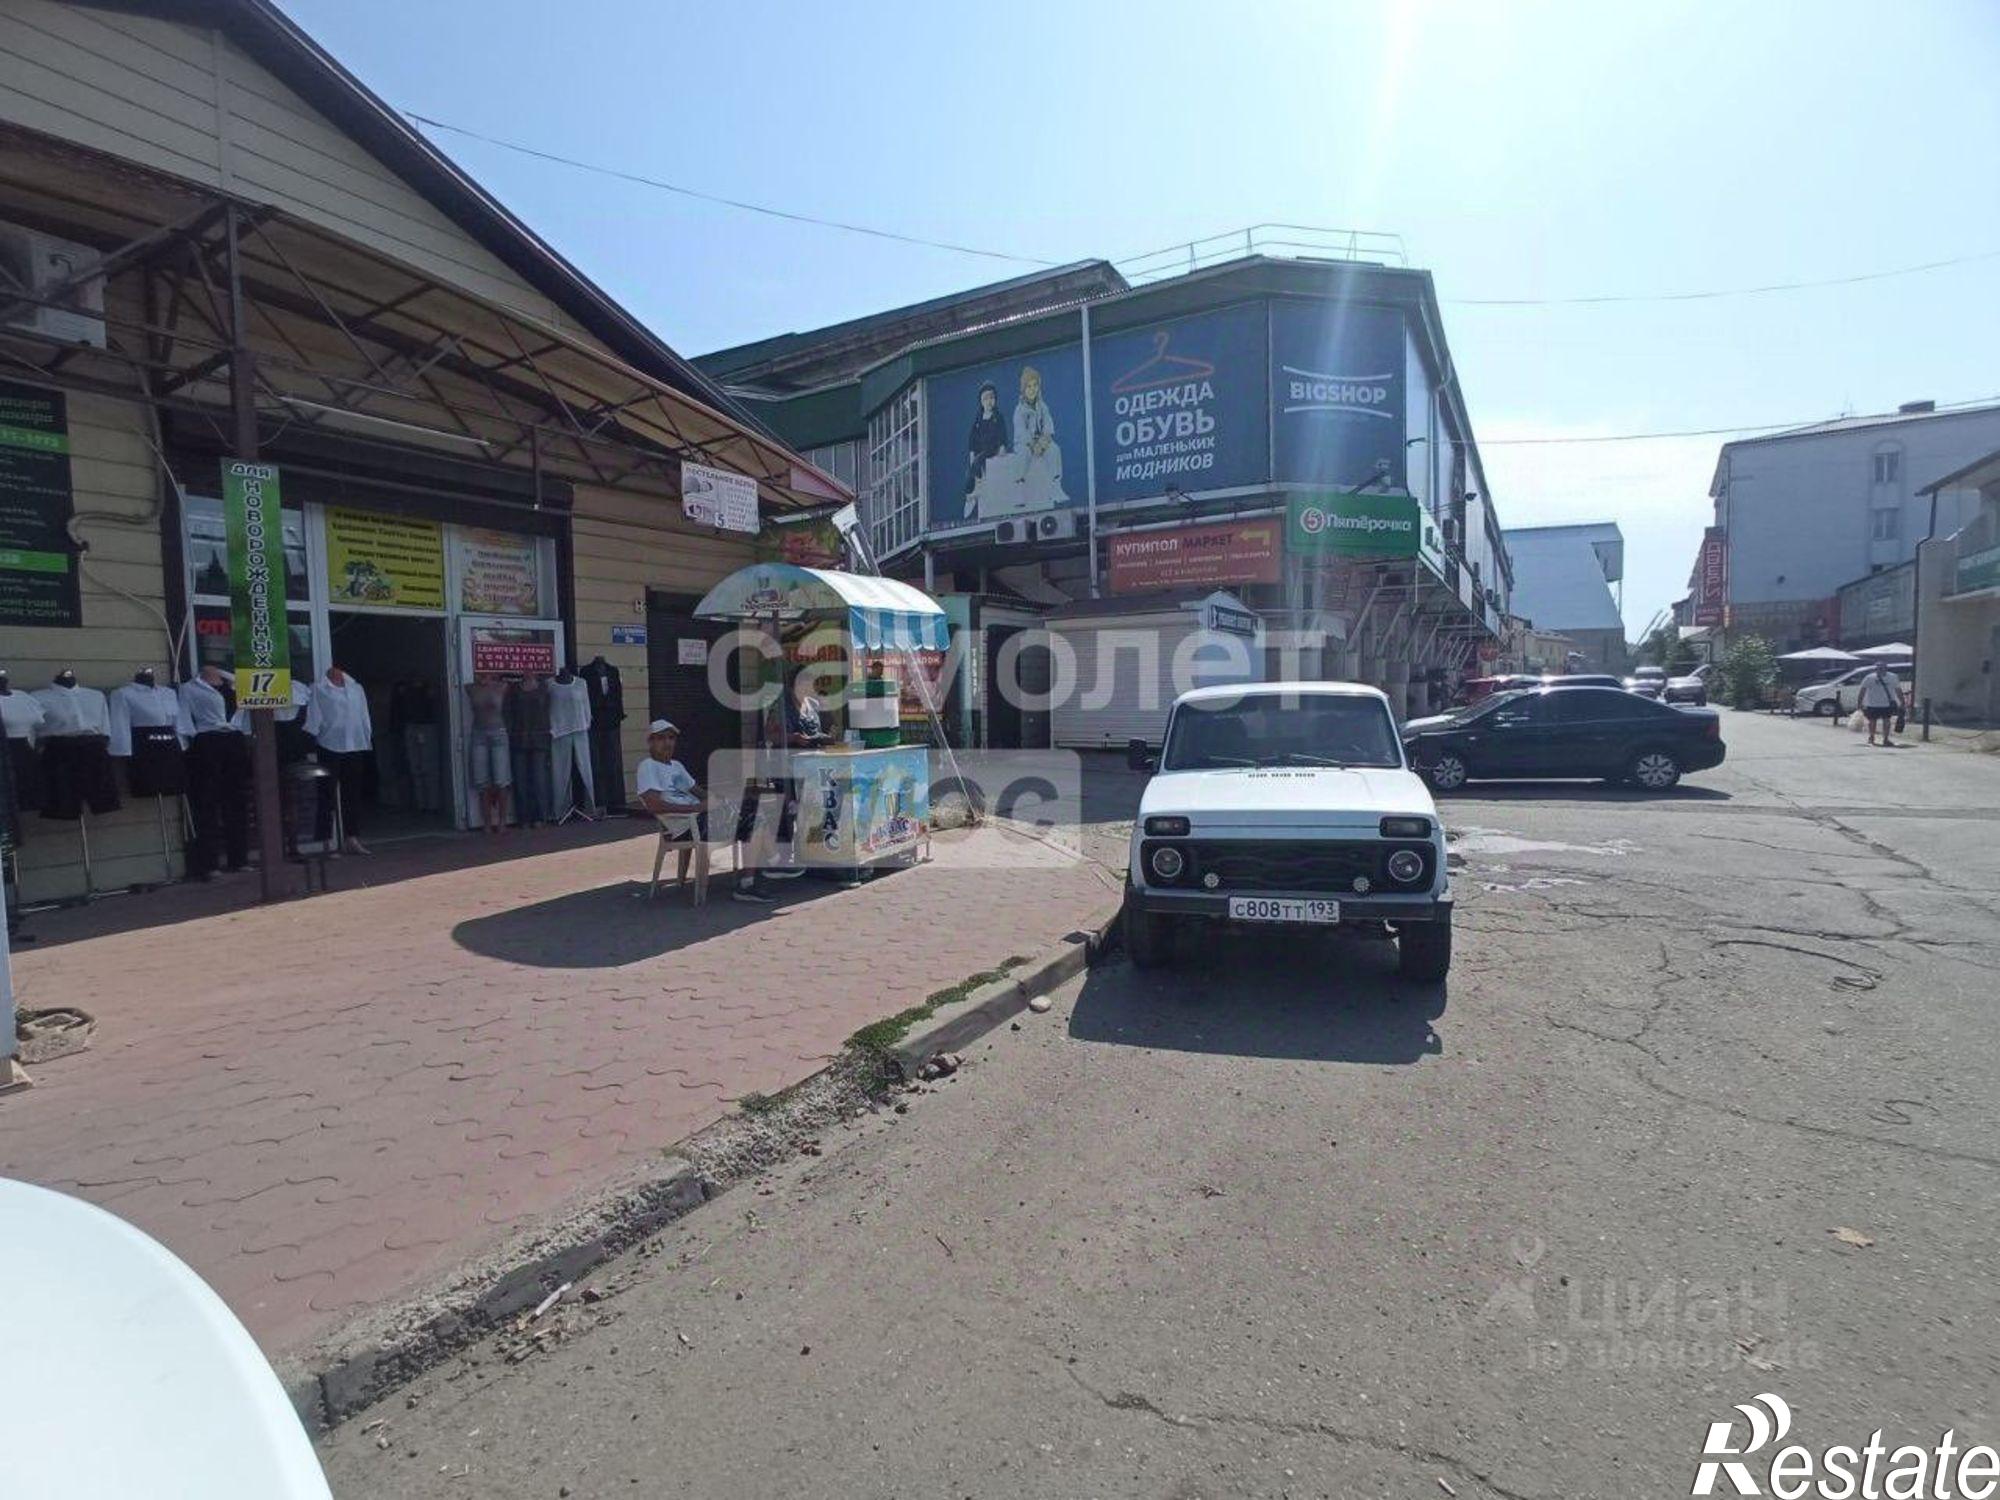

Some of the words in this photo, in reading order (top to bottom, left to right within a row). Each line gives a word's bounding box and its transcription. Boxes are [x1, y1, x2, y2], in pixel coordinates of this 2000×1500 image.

[1115, 381, 1215, 417] ОДЕЖДА
[1289, 380, 1387, 405] BIGSHOP
[1115, 409, 1216, 447] ОБУВЬ
[1133, 436, 1216, 461] МАЛЕНЬКИХ
[230, 463, 271, 479] ДЛЯ
[1115, 452, 1214, 482] МОДНИКОВ
[243, 478, 272, 668] НОВОРОЖДЕННЫХ
[250, 672, 274, 694] 17
[817, 767, 841, 853] КВАС
[1308, 902, 1336, 917] 193
